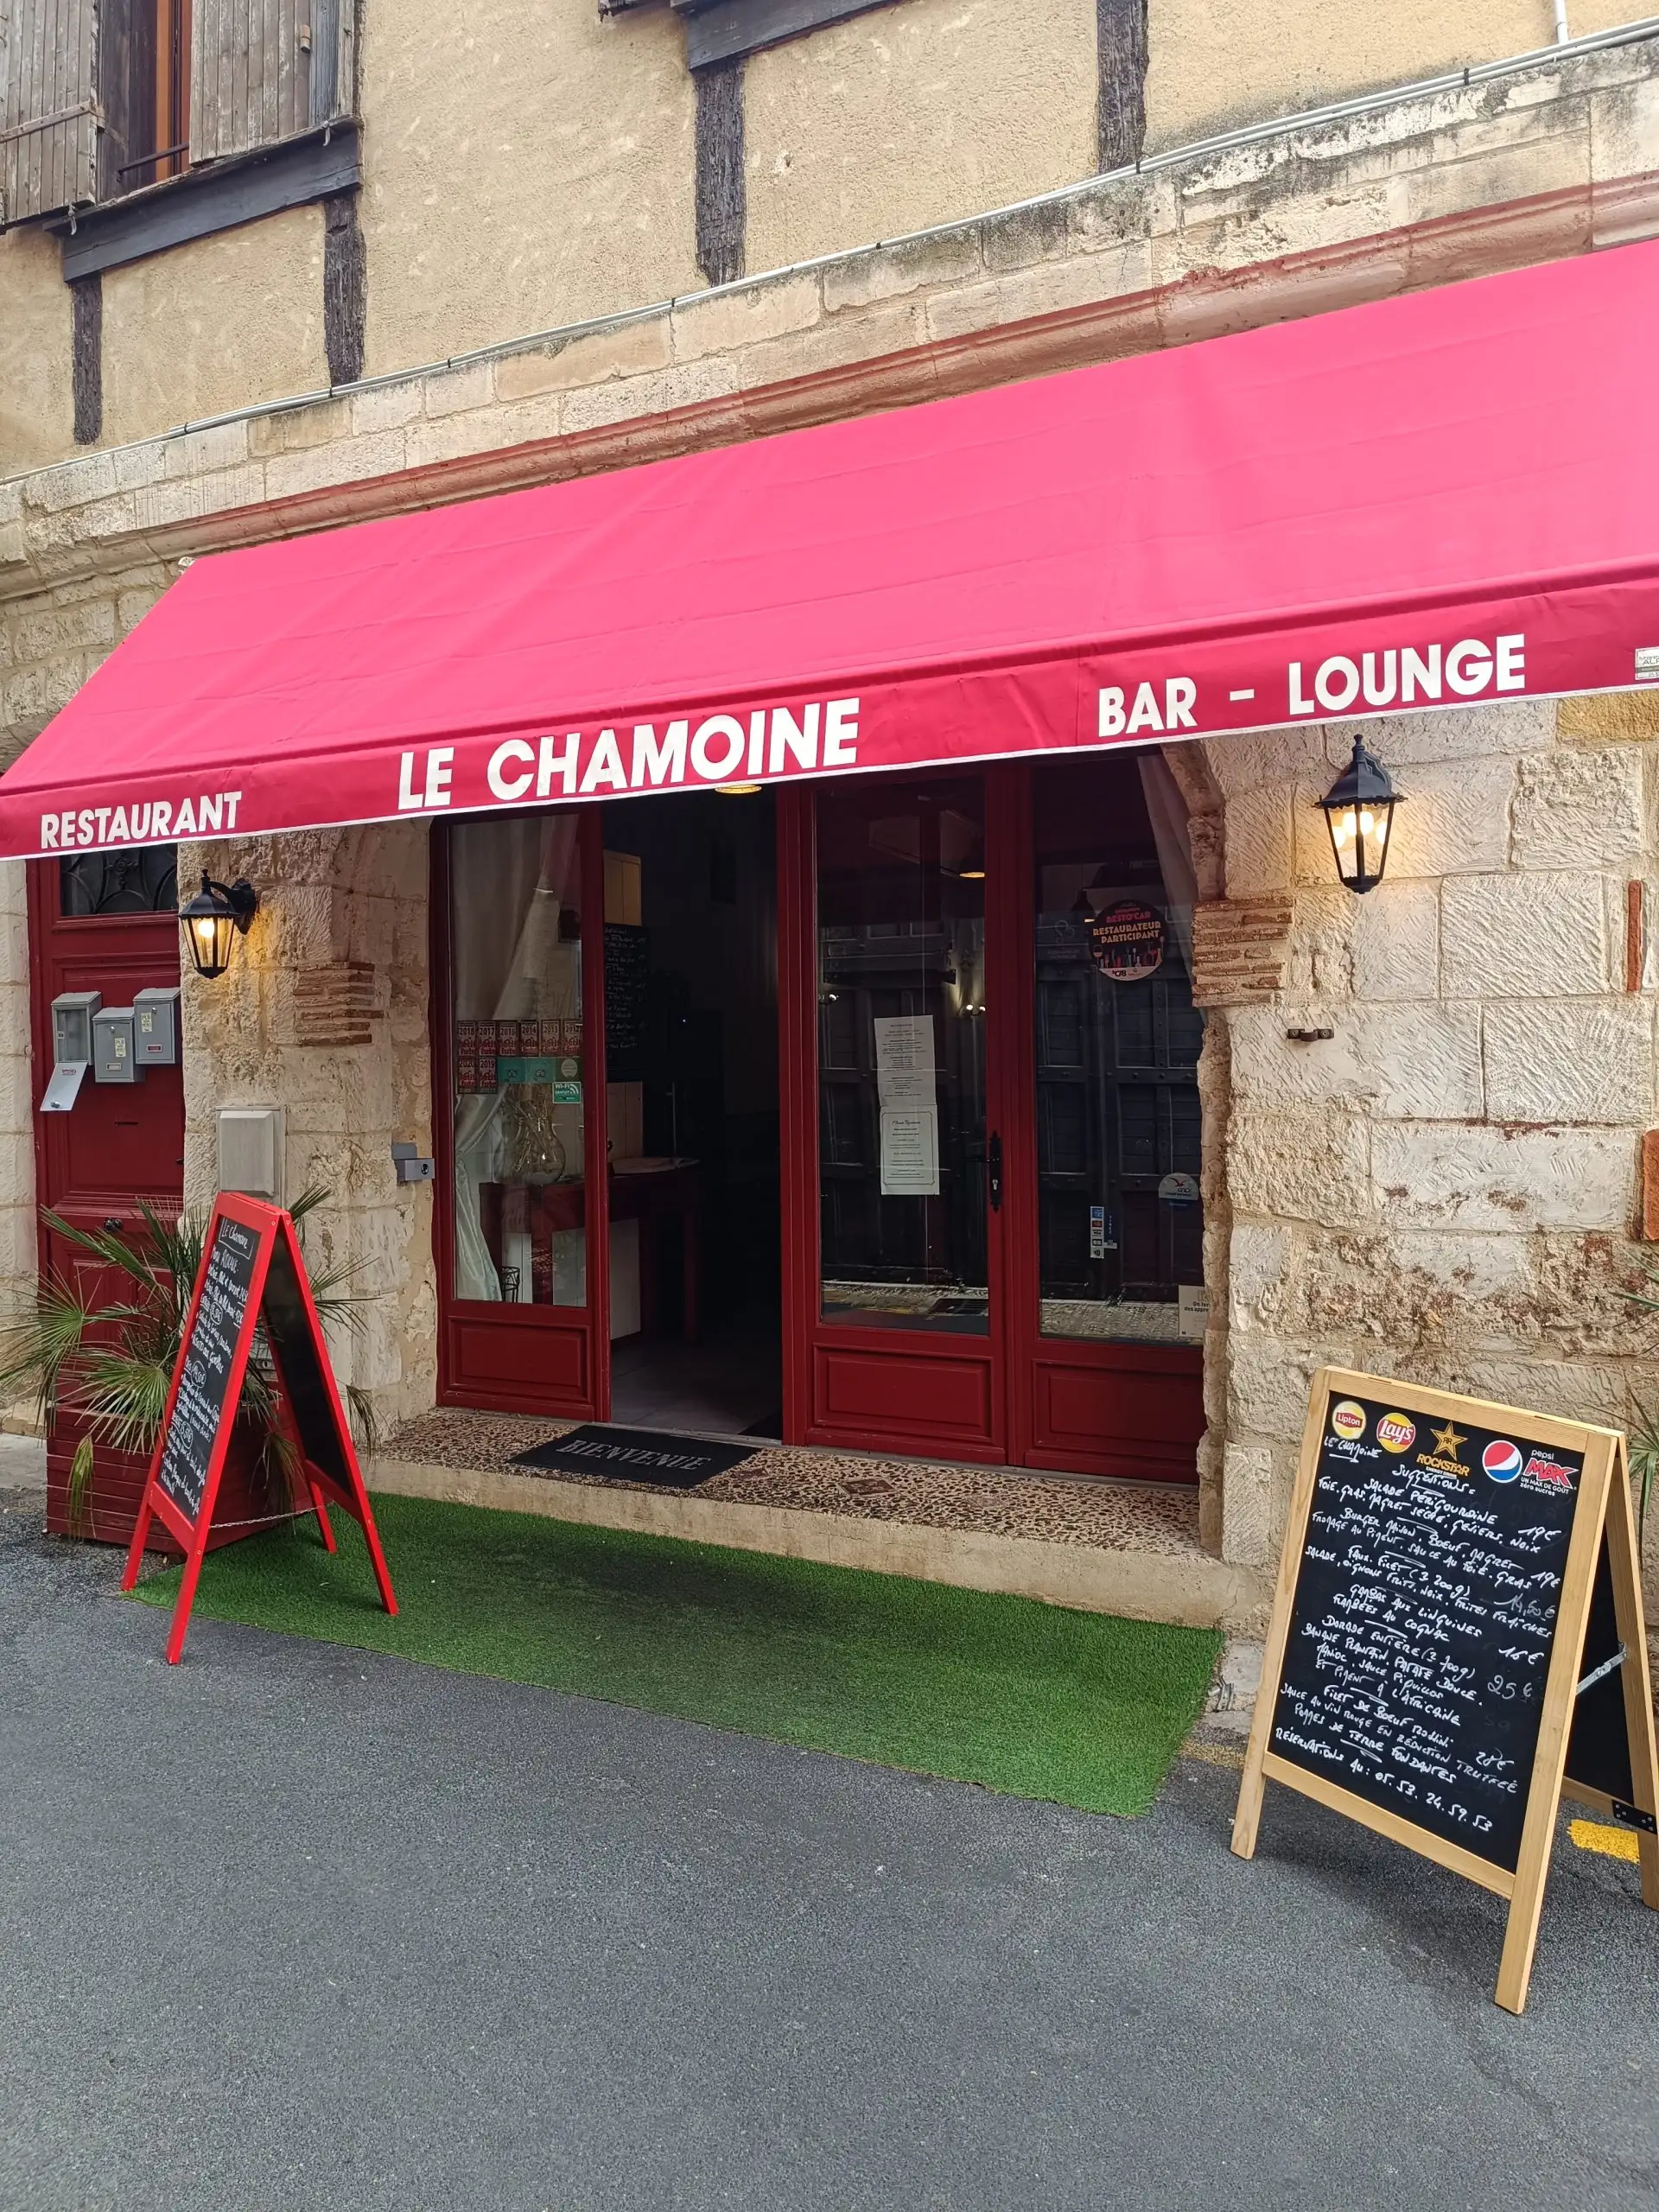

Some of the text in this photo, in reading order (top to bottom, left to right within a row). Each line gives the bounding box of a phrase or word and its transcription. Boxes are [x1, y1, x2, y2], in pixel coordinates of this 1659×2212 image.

[1098, 677, 1198, 738] BAR
[1289, 633, 1527, 715] LOUNGE
[398, 697, 861, 810] LE CHAMOINE
[41, 791, 243, 849] RESTAURANT
[1092, 921, 1161, 936] RESTAURATEUR
[1101, 931, 1160, 944] PARTICIPANT
[479, 1027, 495, 1036] 2017
[522, 1026, 537, 1034] 2014
[480, 1058, 496, 1069] 2019
[1338, 1414, 1361, 1426] Lipton
[1324, 1435, 1337, 1447] LE
[1382, 1421, 1414, 1444] Lay's
[556, 1440, 711, 1470] BIENVENUE
[1416, 1453, 1471, 1477] ROCKSTAR
[1531, 1449, 1554, 1460] pepsi
[1522, 1458, 1580, 1489] MAX
[1363, 1478, 1405, 1497] SALADE
[1520, 1482, 1555, 1497] zéro sucres
[1340, 1508, 1381, 1529] BURGER
[1351, 1524, 1362, 1535] AU
[1408, 1542, 1441, 1559] SAUCE
[1443, 1555, 1458, 1567] AU
[1494, 1571, 1532, 1589] GRAS
[1350, 1584, 1483, 1637] GAMBAS AUX LINGUINES
[1321, 1615, 1364, 1635] DORADE
[1382, 1609, 1396, 1623] AU
[1404, 1618, 1450, 1643] COGNAC
[1301, 1623, 1341, 1643] BANANE
[1394, 1656, 1435, 1681] PATATE
[1358, 1659, 1388, 1676] SAUCE
[1280, 1682, 1308, 1700] SAUCE
[1310, 1695, 1322, 1707] AU
[1324, 1702, 1342, 1714] VIN
[1343, 1710, 1373, 1729] ROUGE
[1376, 1725, 1393, 1737] EN
[1323, 1684, 1355, 1703] FILET
[1353, 1700, 1370, 1713] DE
[1328, 1721, 1344, 1732] DE
[1348, 1730, 1384, 1751] TERRE
